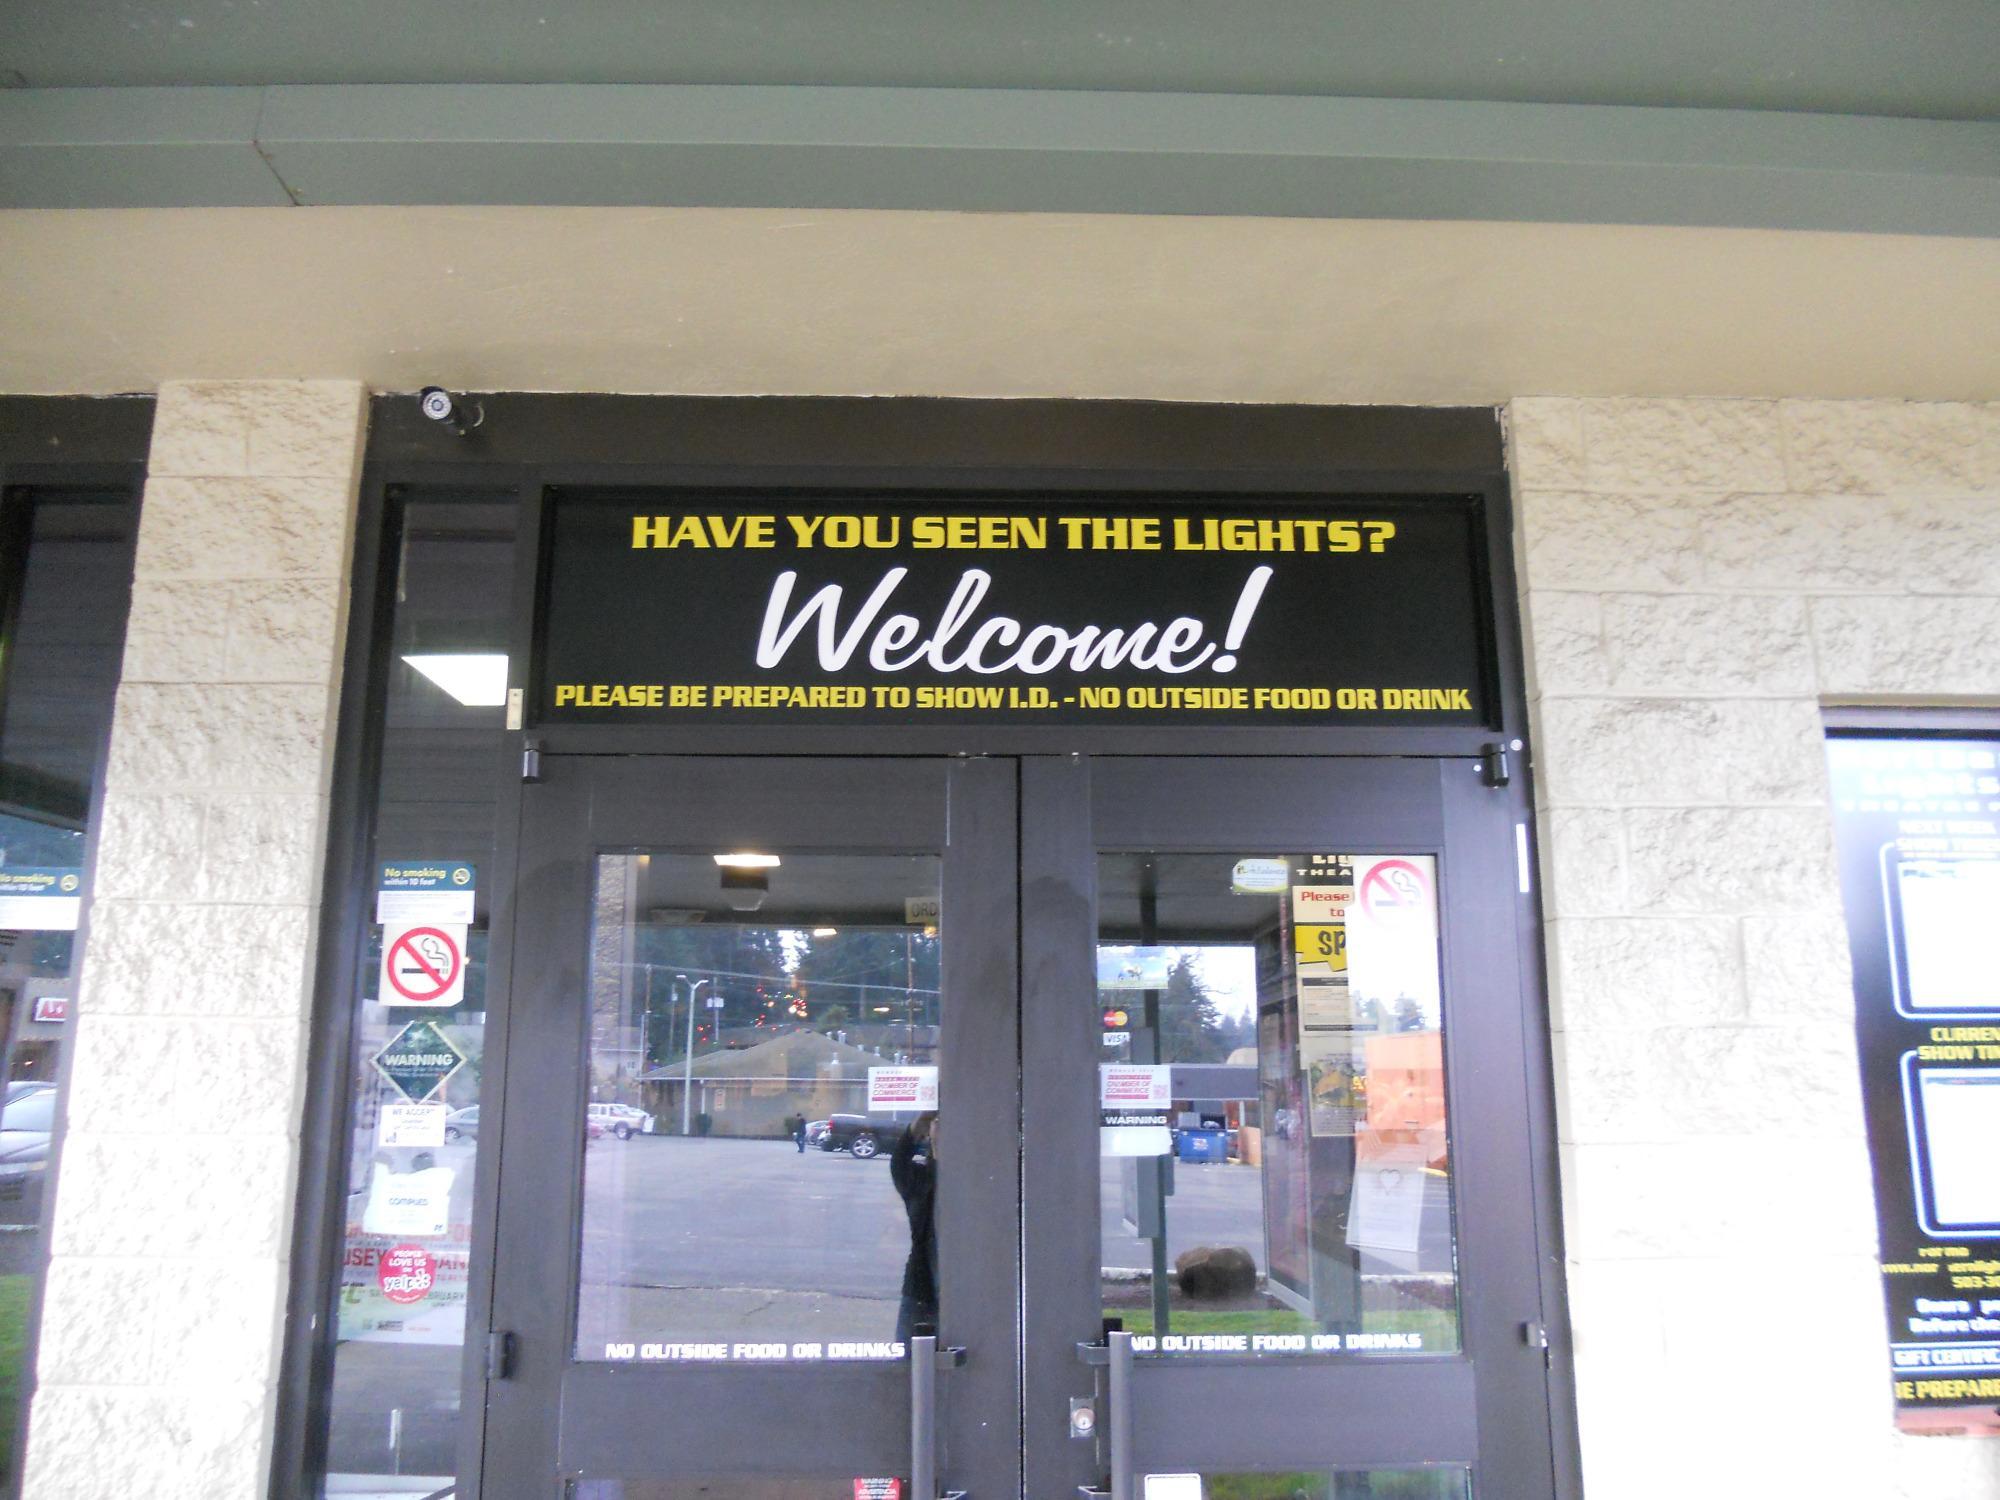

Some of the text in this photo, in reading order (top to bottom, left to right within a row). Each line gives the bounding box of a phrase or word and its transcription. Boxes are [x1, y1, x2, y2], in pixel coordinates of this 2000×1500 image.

[632, 516, 1396, 553] HAVE YOU SEEN THE LIGHTS?
[756, 566, 1273, 674] Welcome!
[555, 685, 663, 706] PLEASE
[669, 686, 708, 707] BE
[712, 686, 866, 708] PREPARED
[871, 687, 911, 708] TO
[915, 687, 1004, 708] SHOW
[1009, 687, 1059, 708] I.D.
[1079, 687, 1121, 709] NO
[1126, 688, 1249, 709] OUTSIDE
[1253, 688, 1332, 710] FOOD
[1336, 688, 1378, 710] OR
[1382, 688, 1473, 710] DRINK
[384, 868, 447, 879] No smoking
[1301, 891, 1350, 902] Please
[1330, 908, 1345, 917] to
[1318, 930, 1346, 956] SP
[384, 1053, 454, 1065] WARNING
[1918, 1046, 1974, 1060] SHOW
[1105, 1116, 1168, 1124] WARNING
[389, 1257, 413, 1266] LOVE
[414, 1257, 427, 1266] US
[1162, 1336, 1247, 1351] OUTSIDE
[1252, 1335, 1306, 1350] FOOD
[1311, 1335, 1341, 1350] OR
[1346, 1334, 1422, 1349] DRINKS
[605, 1342, 905, 1359] NO OUTSIDE FOOD OR DRINKS
